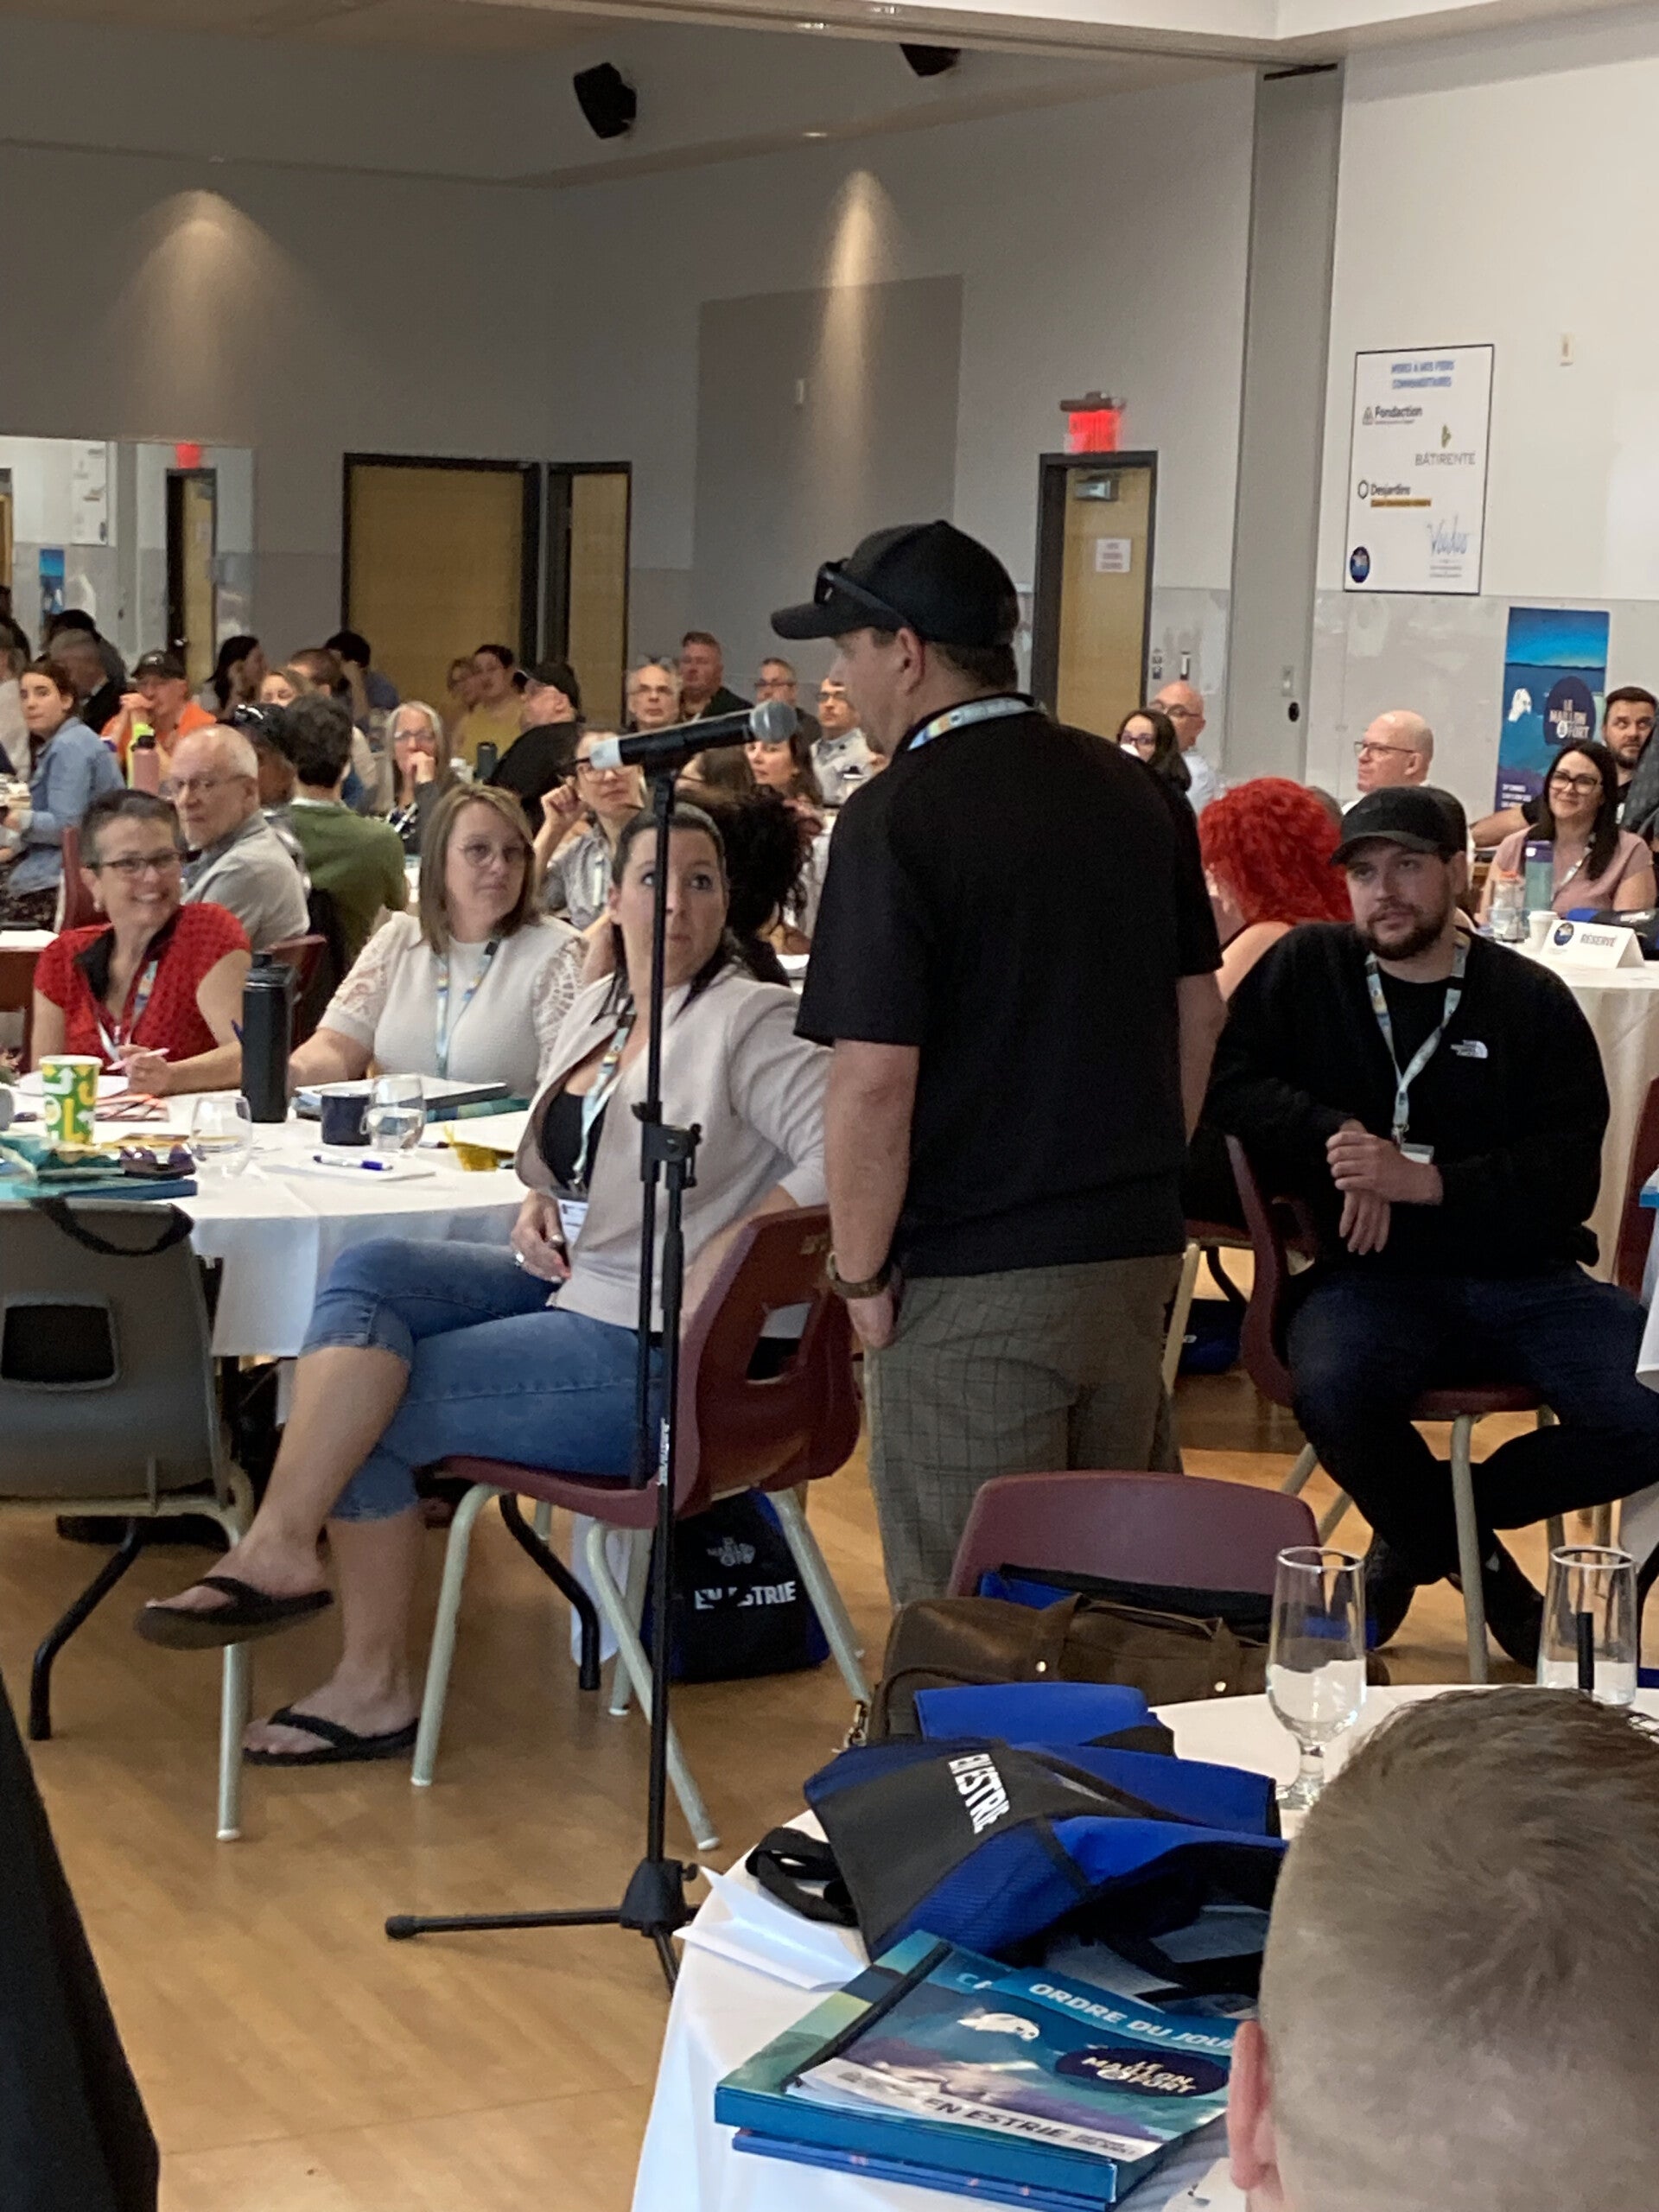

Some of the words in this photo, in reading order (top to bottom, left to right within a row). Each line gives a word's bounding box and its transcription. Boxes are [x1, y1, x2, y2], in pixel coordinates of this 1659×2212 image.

[1375, 405, 1423, 418] Fondaction
[1370, 483, 1410, 498] Desjardins
[954, 1766, 1010, 1834] ESTRIE
[1028, 1983, 1128, 2024] ORDRE
[1127, 2019, 1173, 2037] DU
[924, 2098, 962, 2113] EN
[964, 2110, 1070, 2137] ESTRIE
